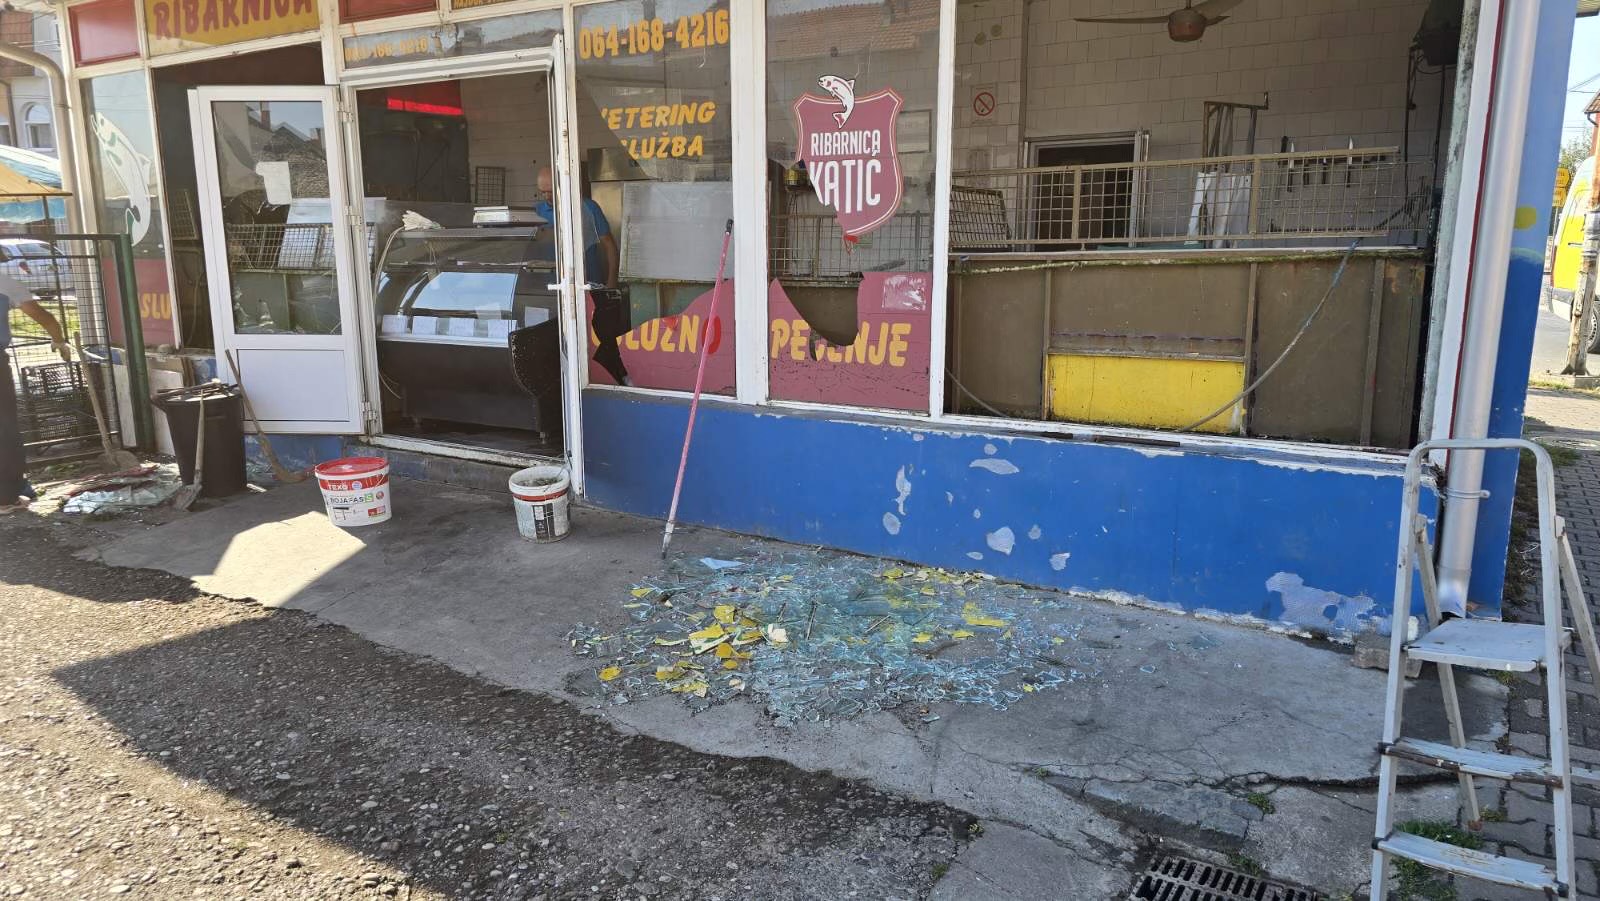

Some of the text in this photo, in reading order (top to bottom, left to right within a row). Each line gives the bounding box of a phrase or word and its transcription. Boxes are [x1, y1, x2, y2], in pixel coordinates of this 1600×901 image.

[578, 9, 730, 60] 064-168-4216
[621, 131, 704, 160] LUŽBA
[811, 129, 880, 156] RIBARNICA
[591, 314, 911, 367] LUŽNO PENJE
